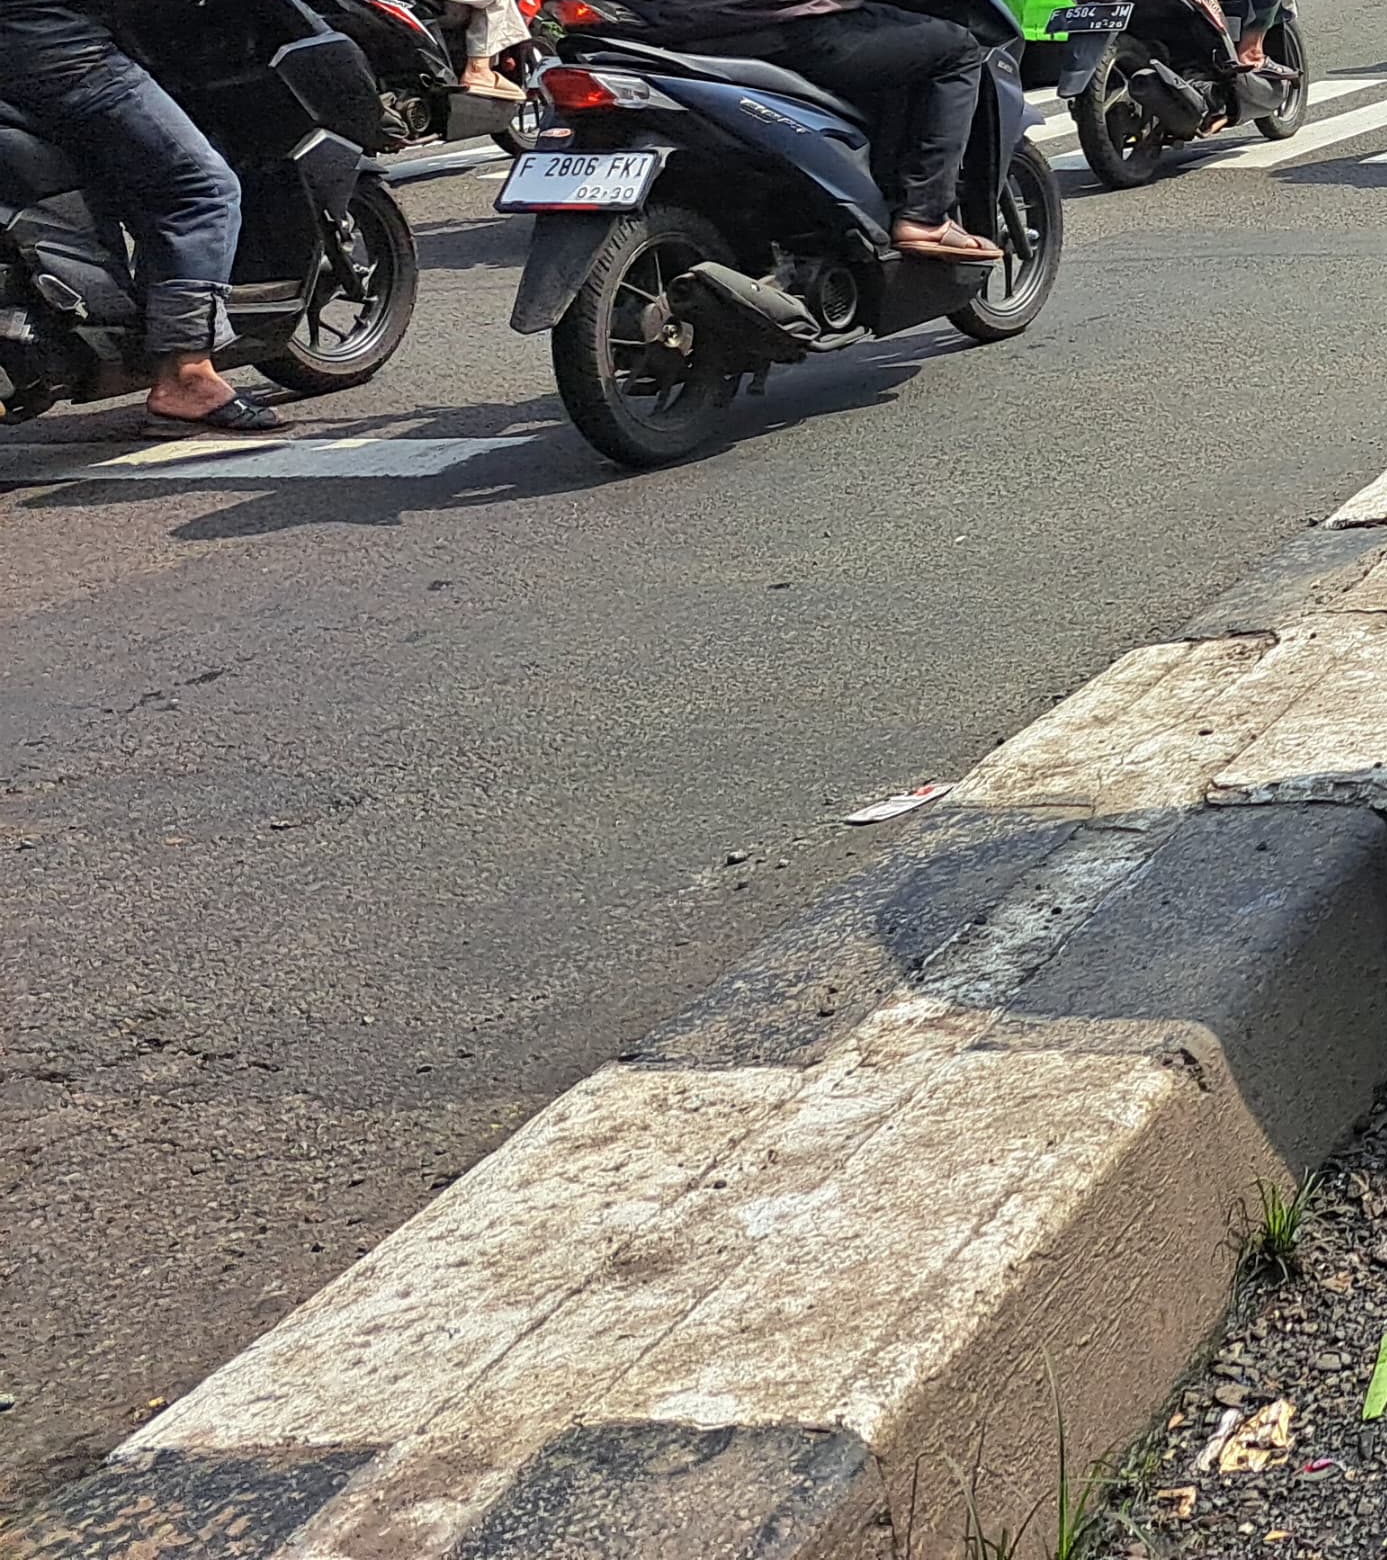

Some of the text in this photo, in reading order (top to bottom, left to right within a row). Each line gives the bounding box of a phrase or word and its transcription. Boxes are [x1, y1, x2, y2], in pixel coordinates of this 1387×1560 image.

[1051, 11, 1061, 21] F
[519, 156, 647, 179] F 2806 FKI
